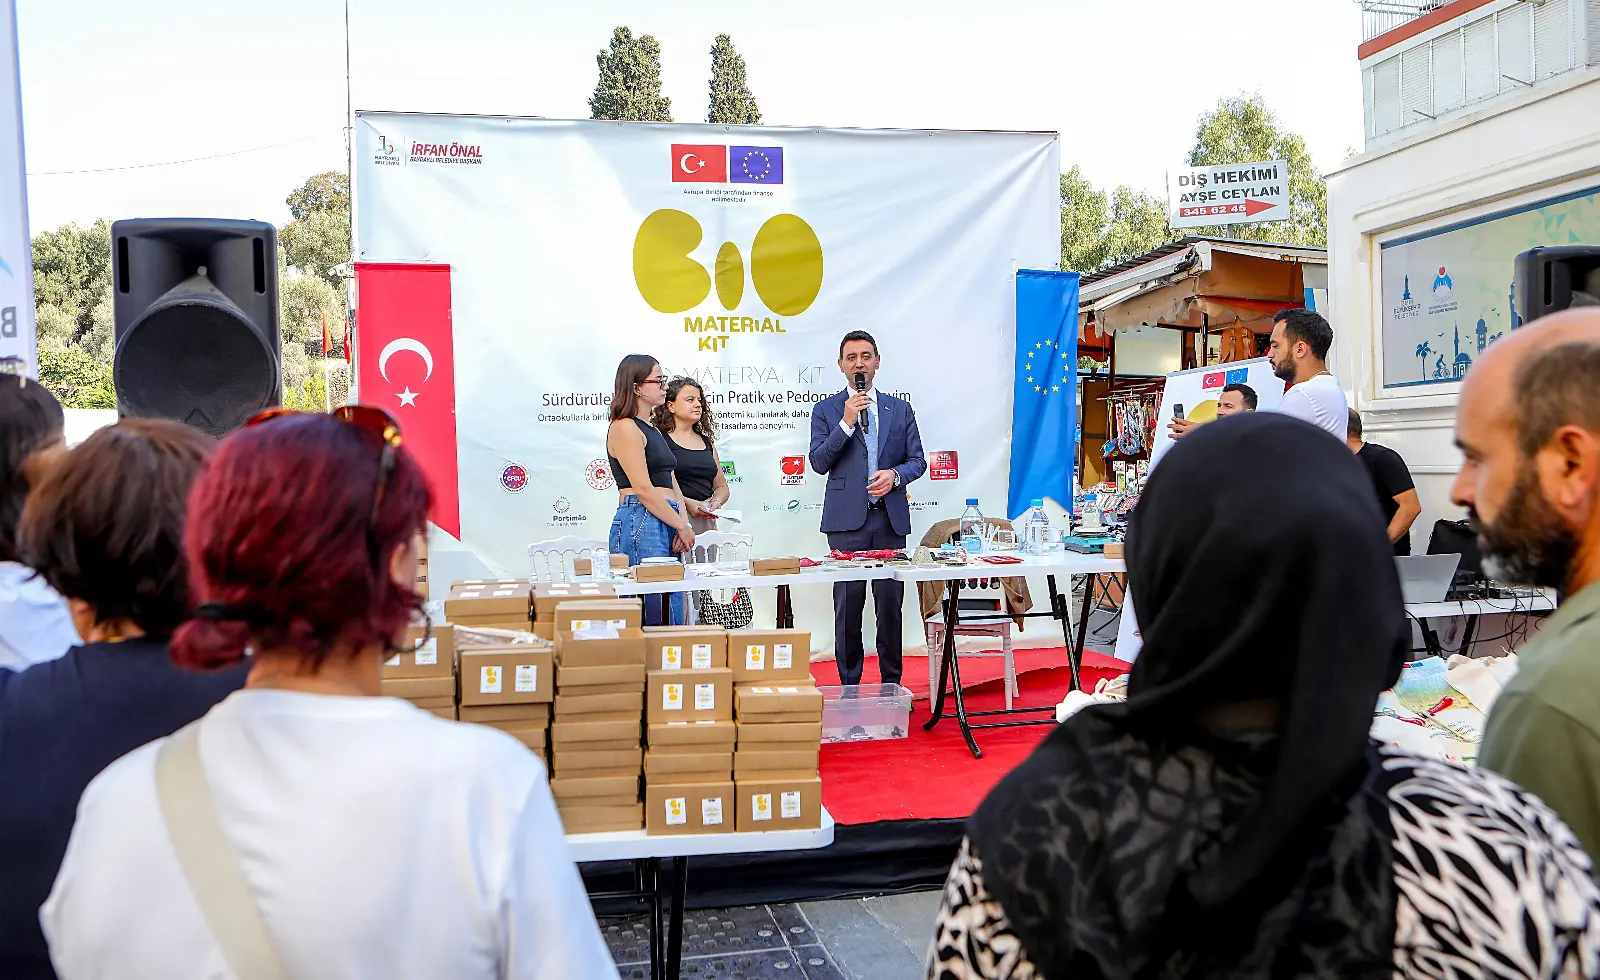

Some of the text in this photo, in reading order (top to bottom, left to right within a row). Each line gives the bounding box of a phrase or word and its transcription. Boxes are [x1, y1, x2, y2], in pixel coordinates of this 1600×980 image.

[411, 140, 483, 158] İRFAN ÖNAL
[1178, 165, 1279, 188] DİŞ HEKİMİ
[1179, 185, 1280, 203] AYŞE CEYLAN
[1183, 204, 1247, 216] 345 62 45
[684, 316, 787, 333] MATERIAL
[698, 335, 729, 352] KIT
[798, 366, 826, 385] KIT
[728, 390, 765, 404] Pratik
[768, 392, 783, 404] ve
[537, 412, 590, 422] Ortaokullarla
[746, 409, 790, 419] kullanılarak,
[791, 409, 810, 418] daha
[721, 421, 758, 430] tasarlama
